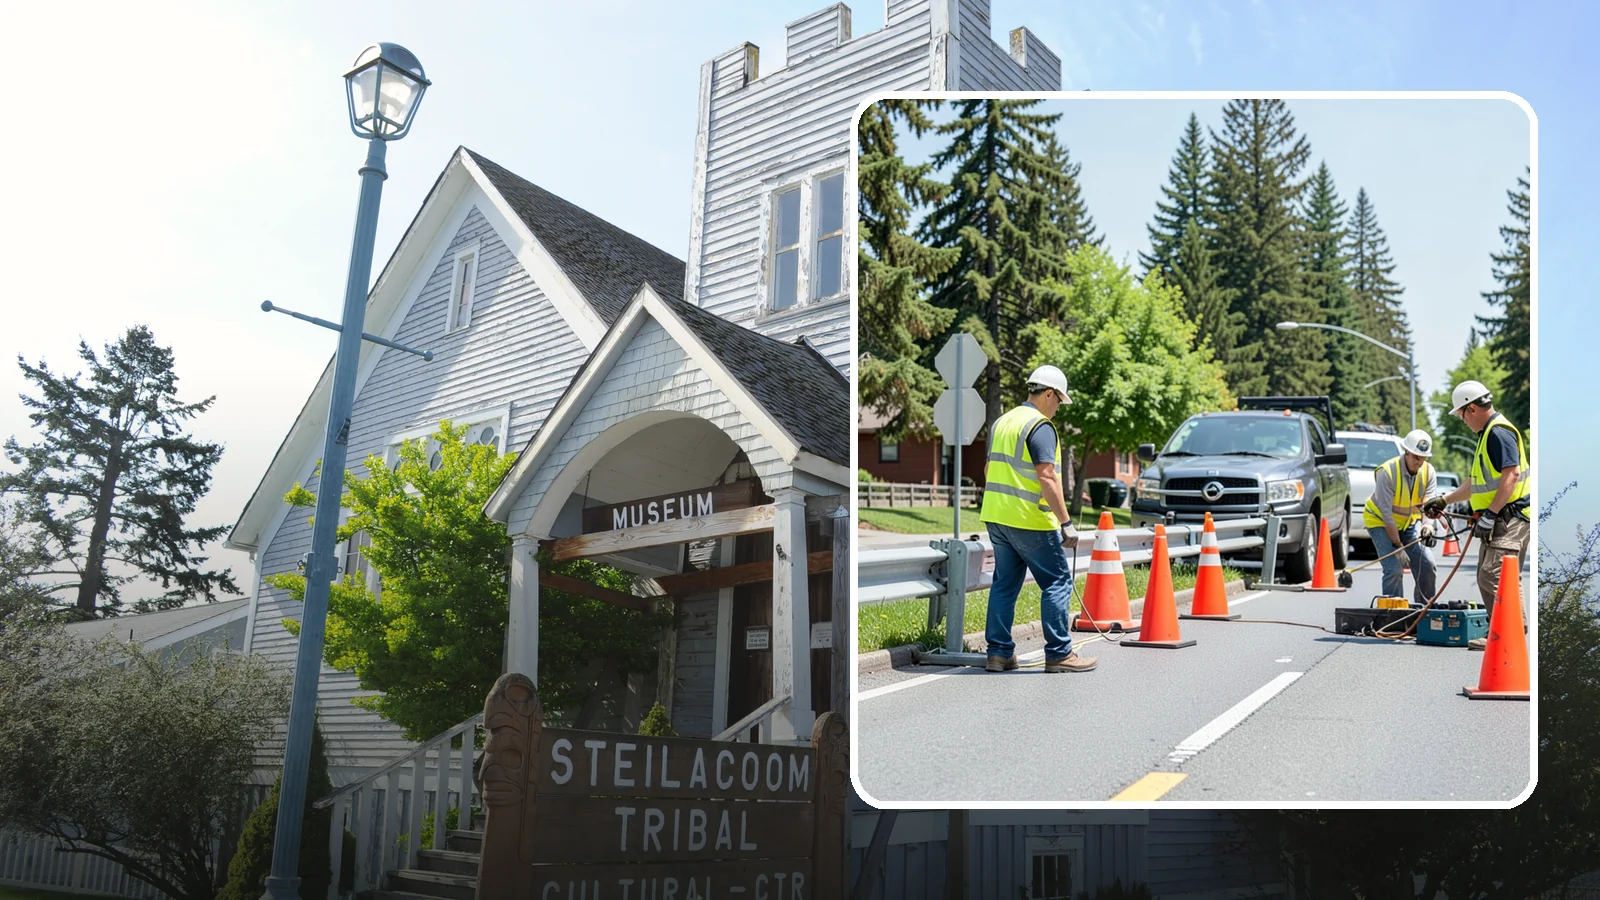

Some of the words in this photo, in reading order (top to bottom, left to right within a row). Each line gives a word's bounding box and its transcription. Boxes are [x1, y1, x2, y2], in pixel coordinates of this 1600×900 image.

[613, 491, 713, 531] MUSEUM
[550, 738, 809, 793] STEILACOOM
[615, 806, 757, 853] TRIBAL
